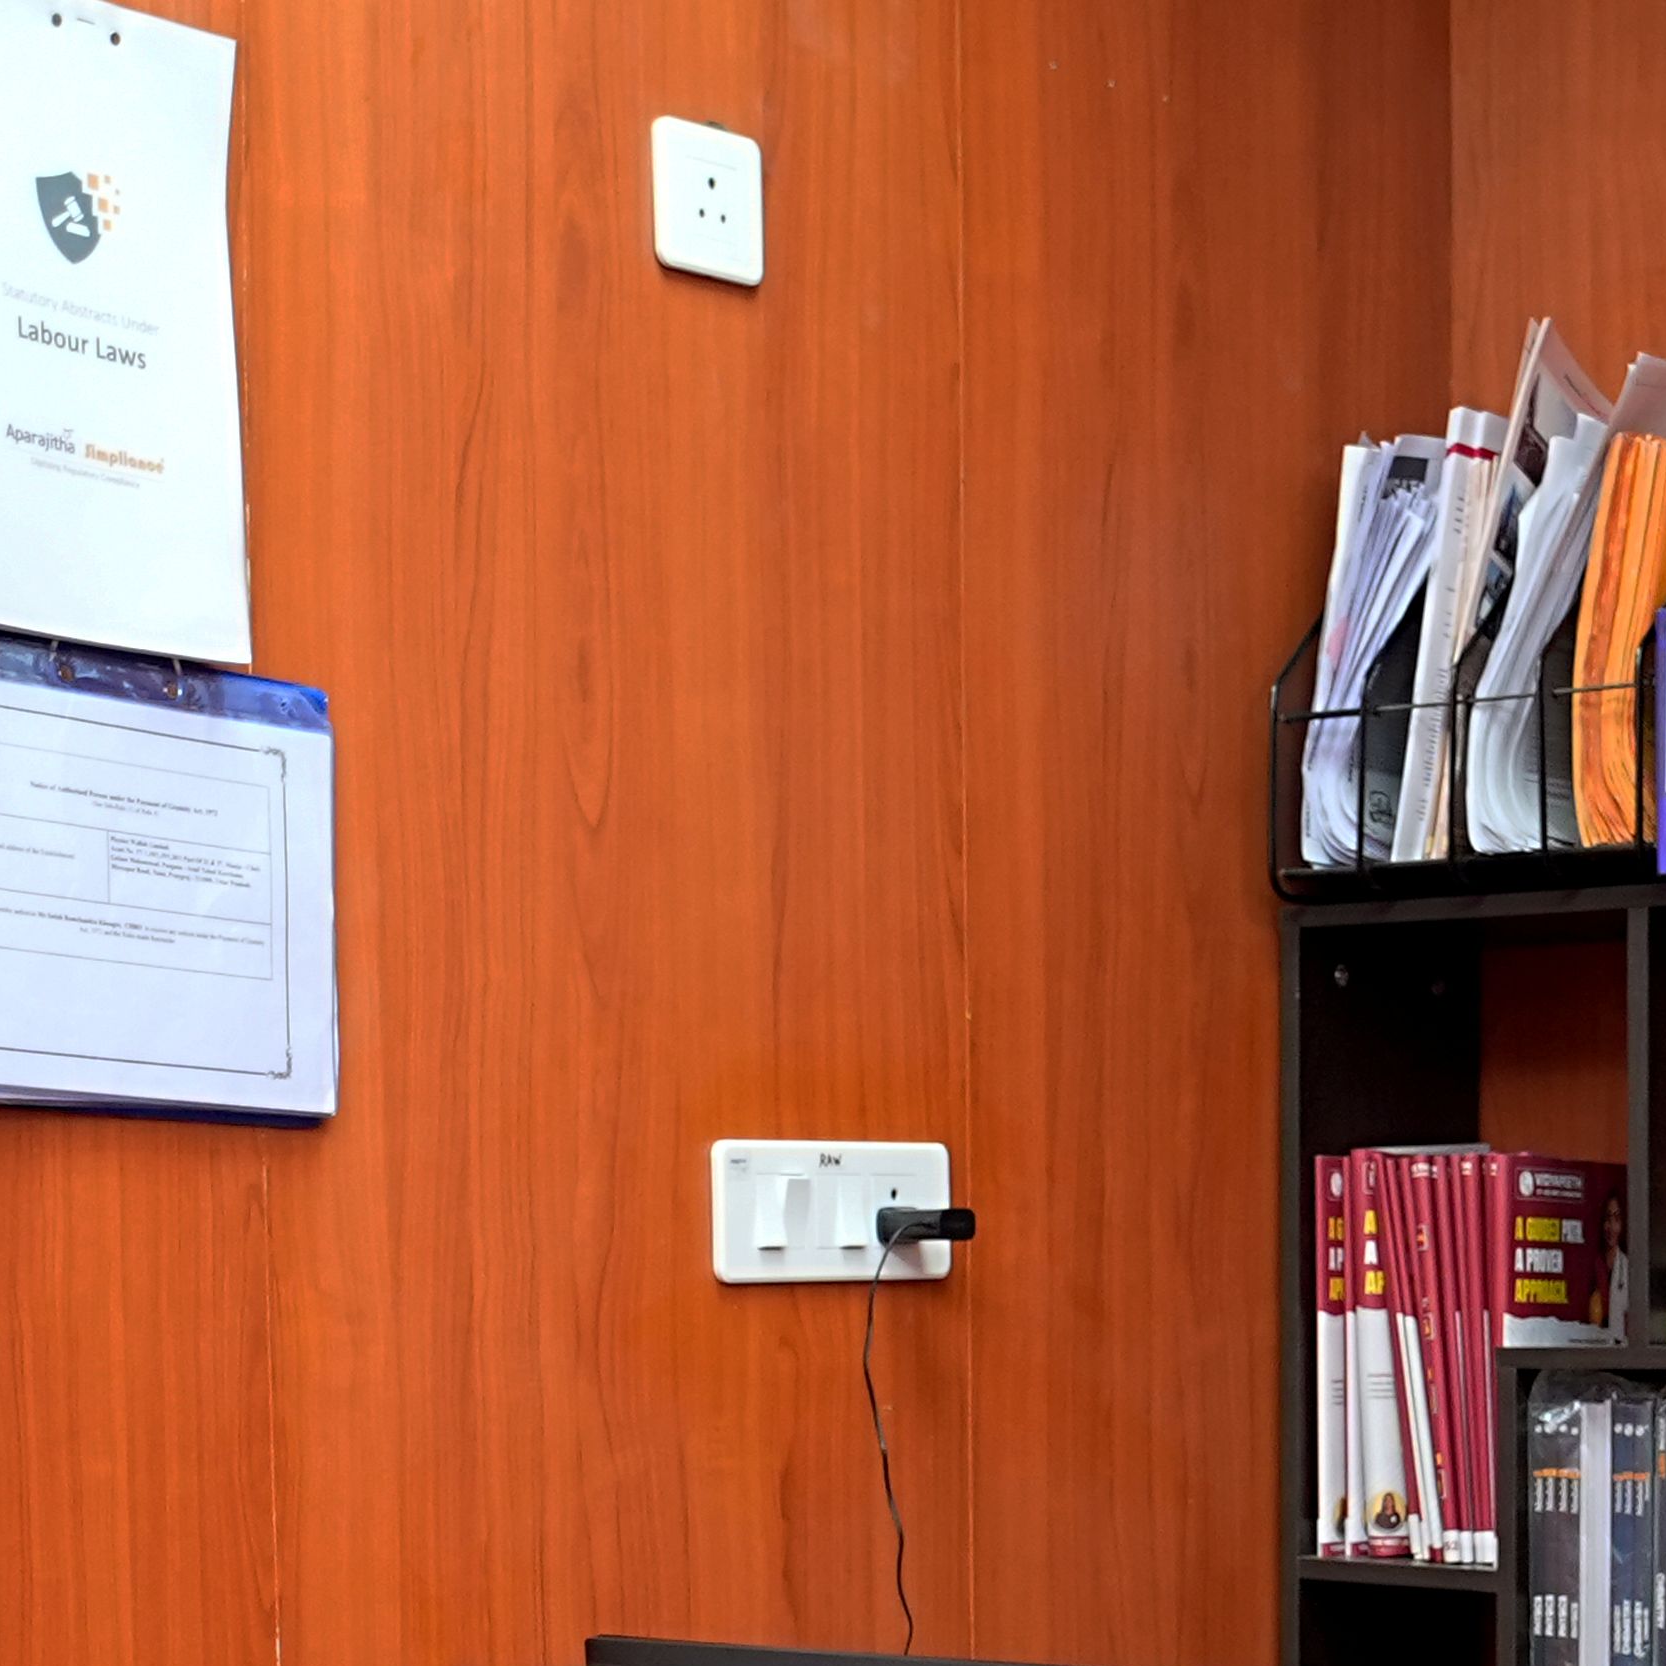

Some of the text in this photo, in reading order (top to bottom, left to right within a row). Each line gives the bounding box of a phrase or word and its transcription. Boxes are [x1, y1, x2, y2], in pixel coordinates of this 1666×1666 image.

[17, 315, 147, 370] Labour Laws
[6, 423, 76, 455] Aparajitha
[819, 1153, 842, 1167] RAW
[1363, 1209, 1378, 1236] A
[1363, 1239, 1378, 1265] A
[1514, 1247, 1524, 1273] A
